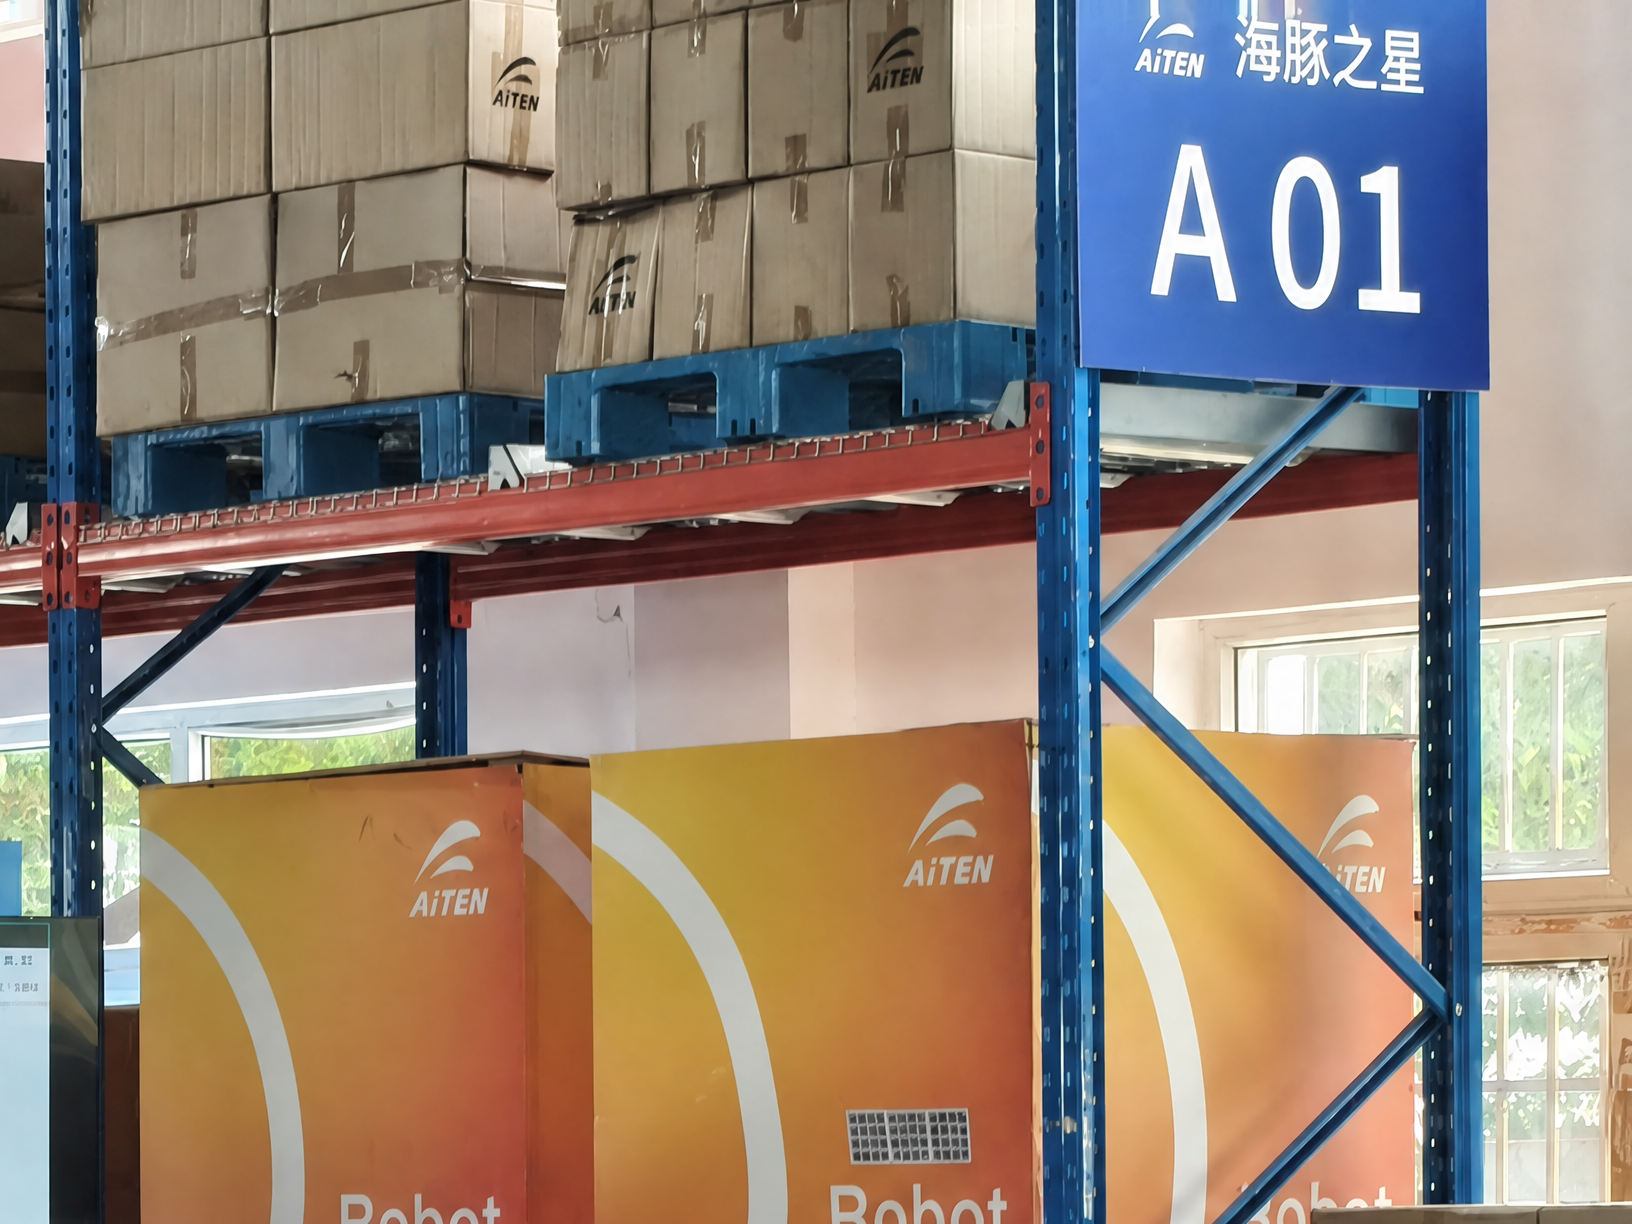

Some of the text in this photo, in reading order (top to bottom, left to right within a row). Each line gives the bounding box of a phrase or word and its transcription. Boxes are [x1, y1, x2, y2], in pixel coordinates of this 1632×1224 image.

[1134, 14, 1424, 94] AiTEN 海豚之星
[867, 66, 924, 93] AiTEN
[492, 89, 540, 112] AiTEN
[1150, 144, 1420, 313] A 01
[903, 854, 994, 888] AiTEN
[1322, 863, 1386, 893] iTEN
[409, 887, 489, 918] AiTEN
